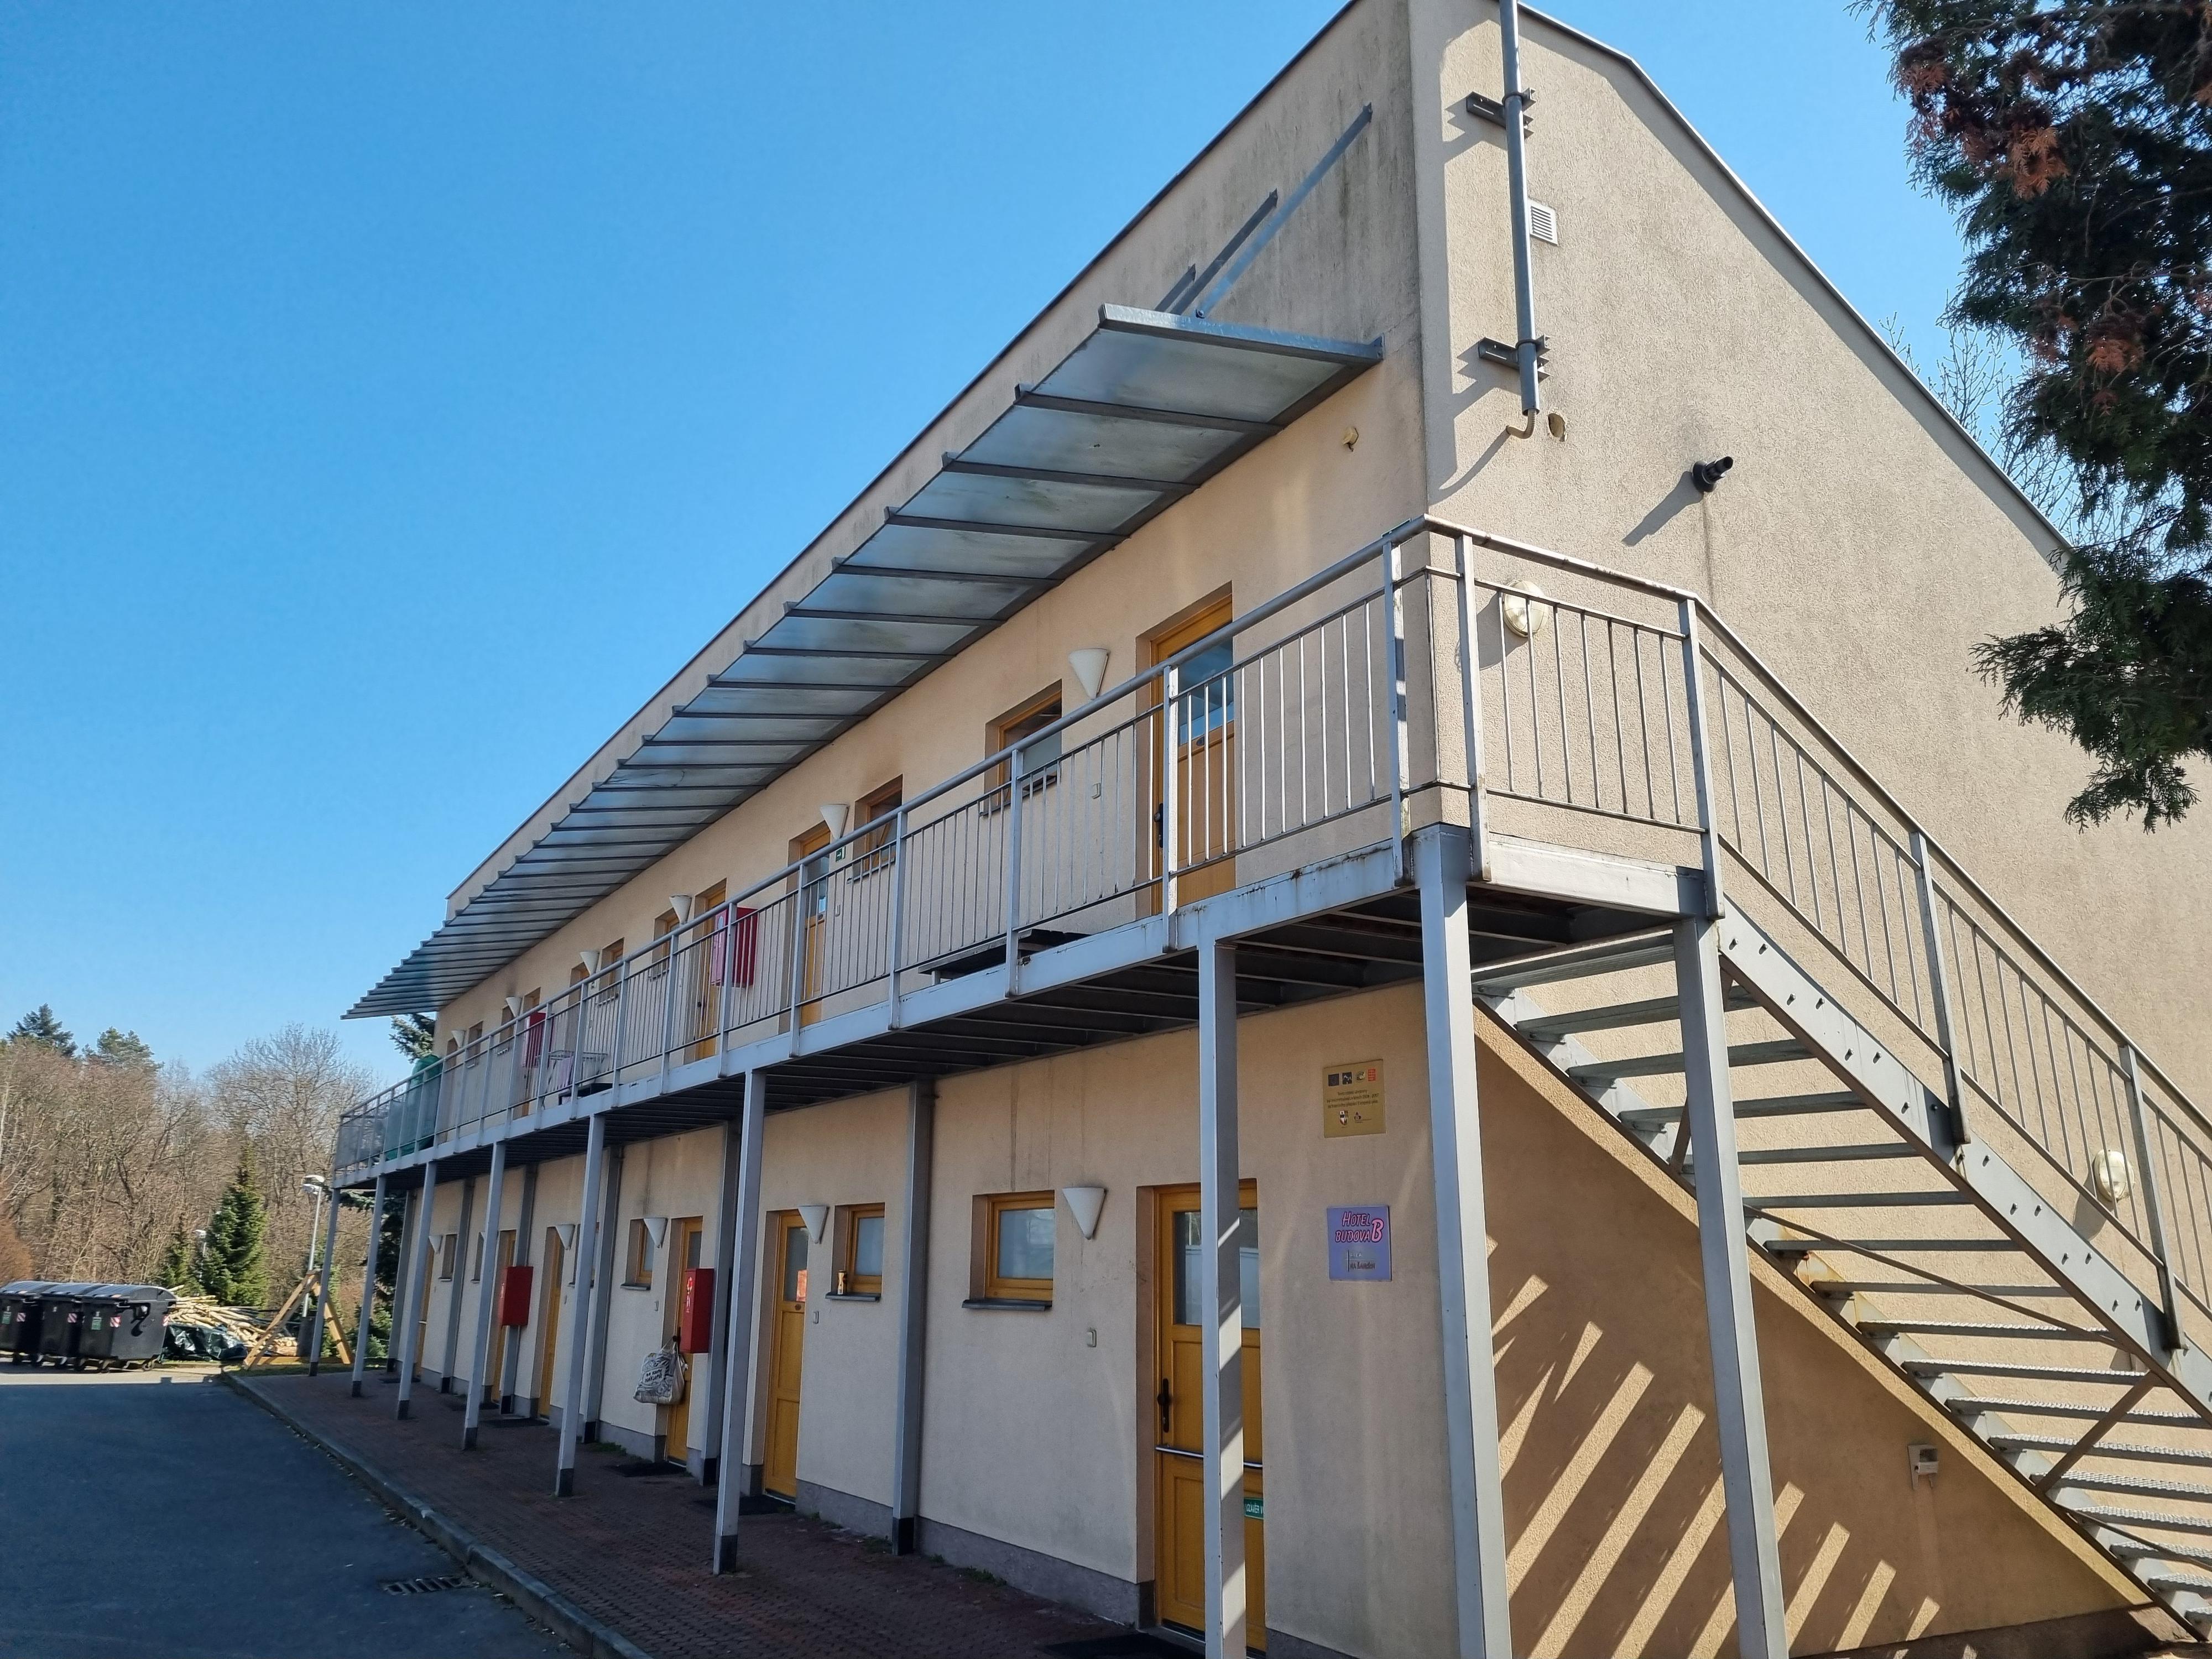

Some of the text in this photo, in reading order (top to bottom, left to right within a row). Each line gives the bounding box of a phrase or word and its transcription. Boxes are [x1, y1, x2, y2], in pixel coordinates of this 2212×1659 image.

[1342, 1211, 1371, 1227] HOTEL
[1335, 1218, 1385, 1243] BUDOVA B
